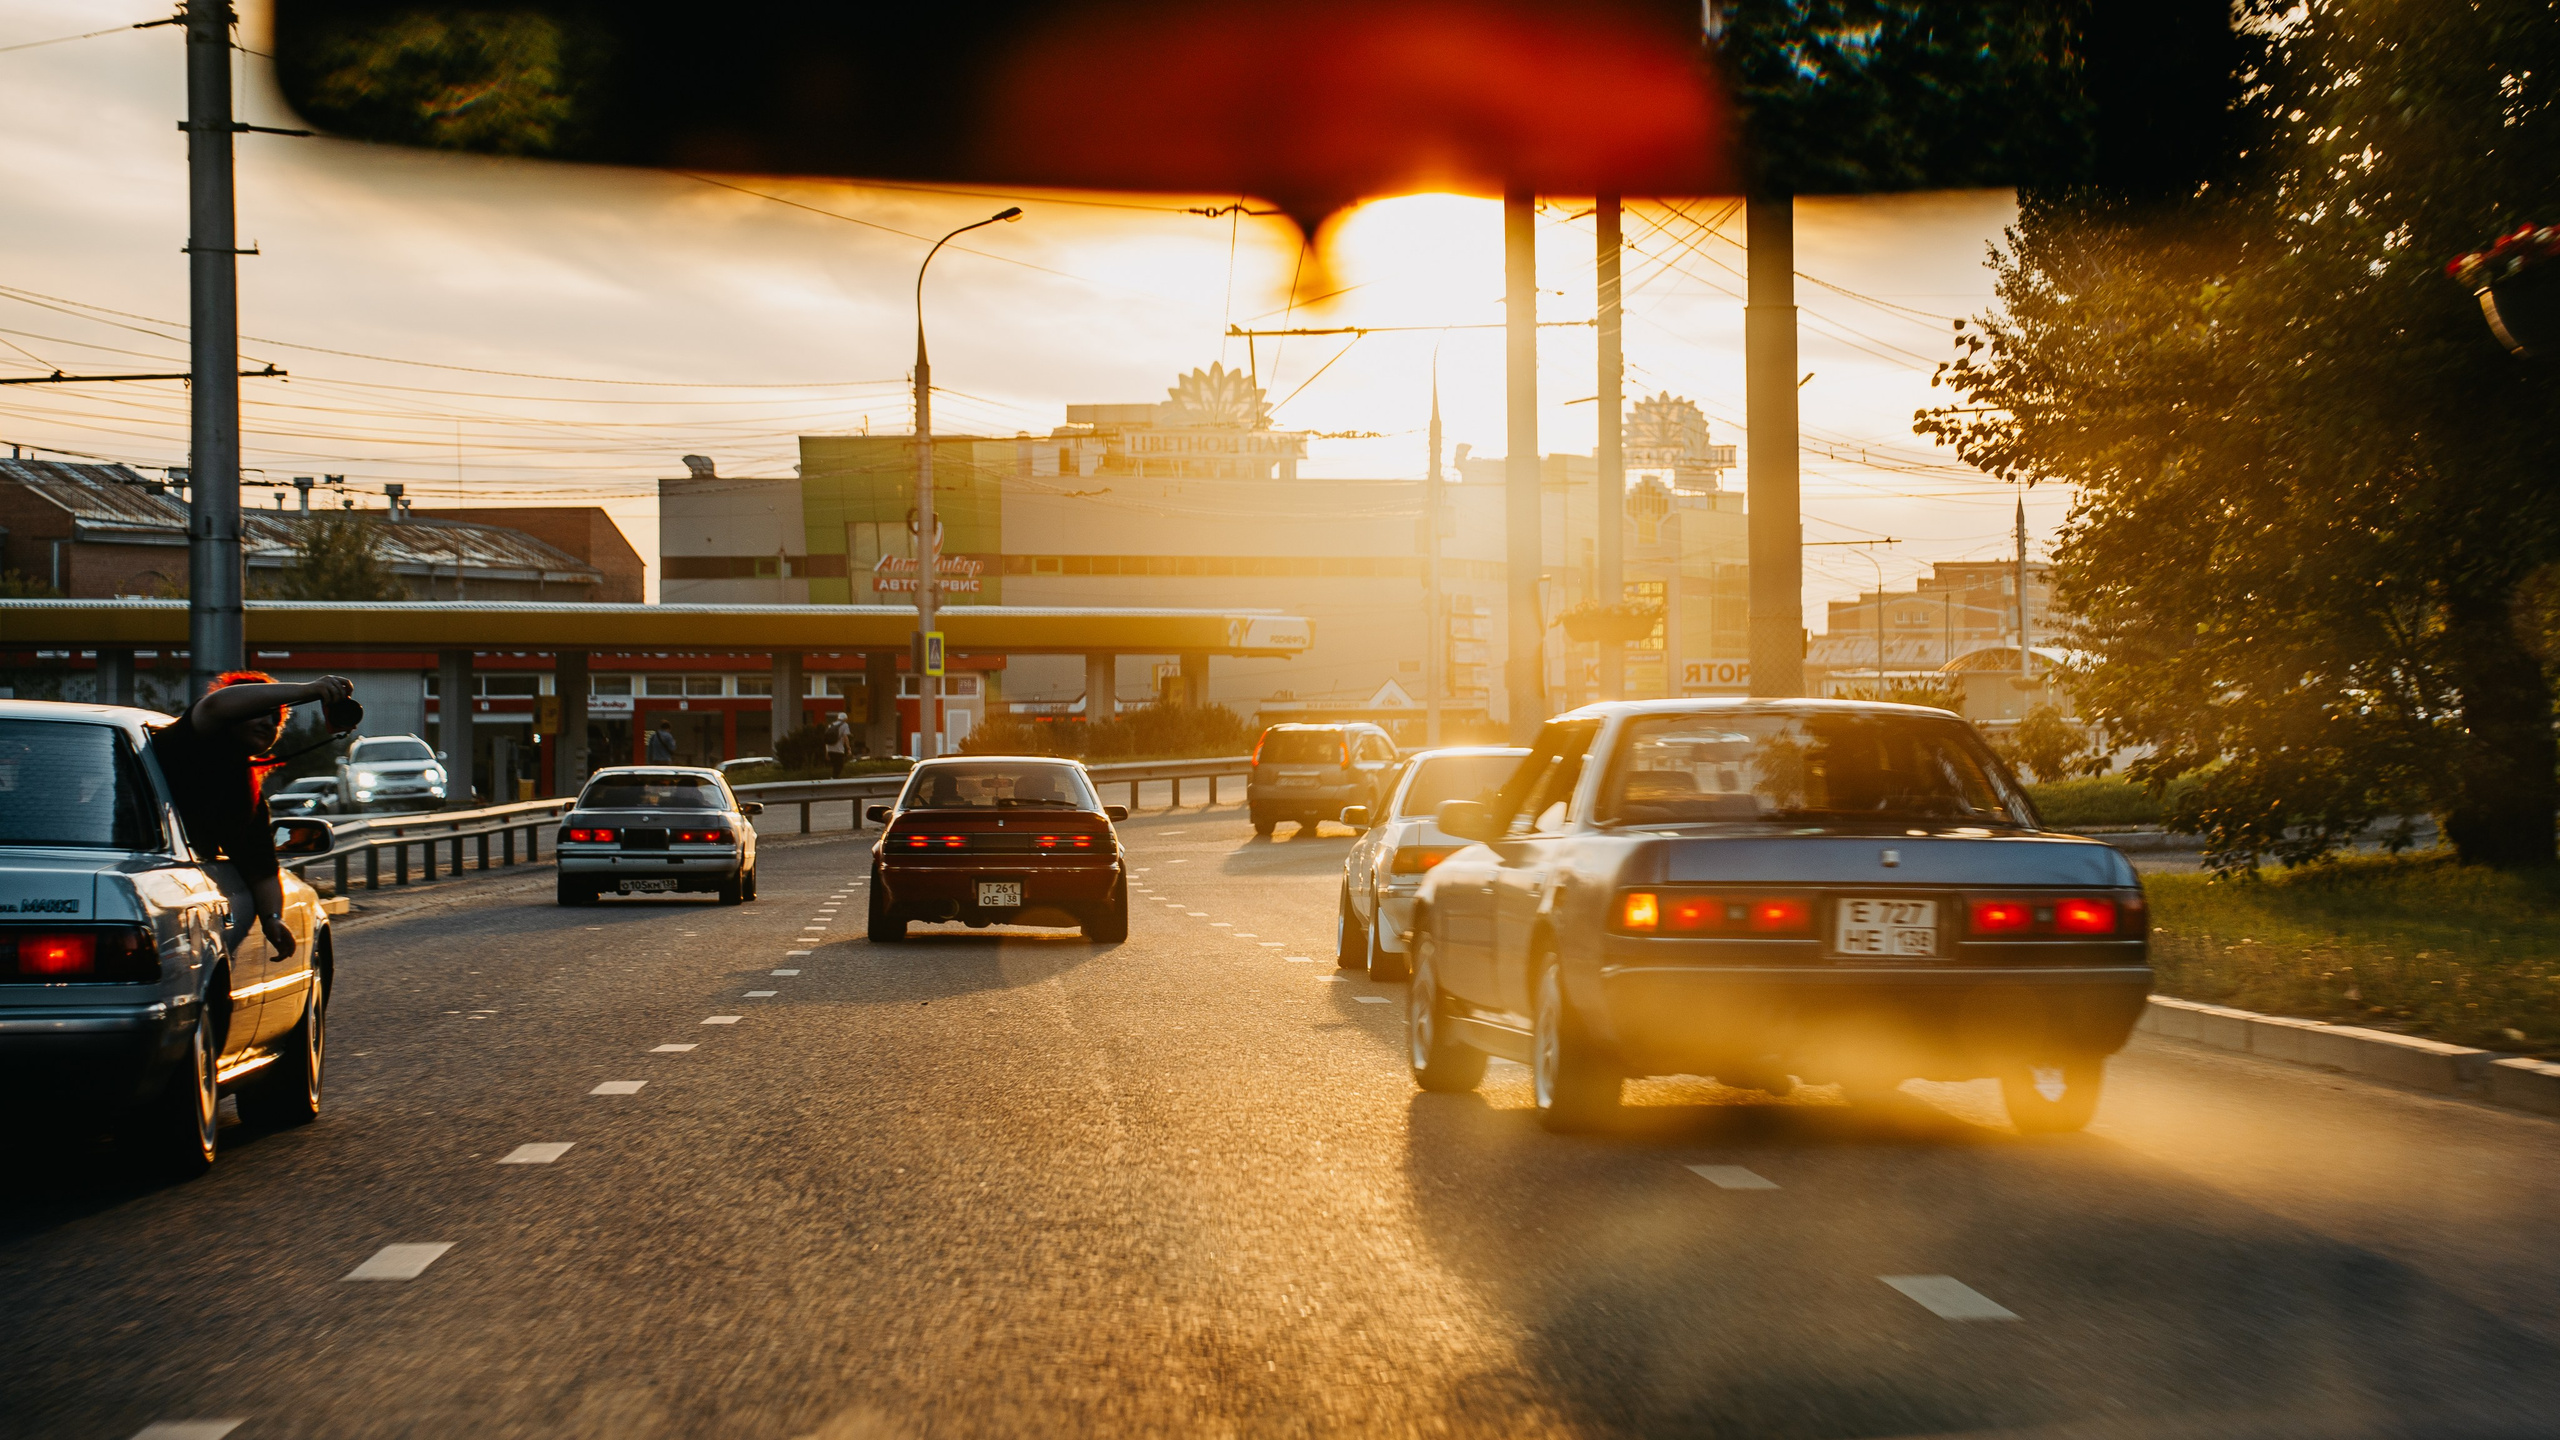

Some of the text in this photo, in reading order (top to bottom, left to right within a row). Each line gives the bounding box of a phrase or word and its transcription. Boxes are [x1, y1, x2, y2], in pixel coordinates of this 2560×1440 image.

[1247, 435, 1303, 455] ПАРК
[995, 884, 1015, 893] 261
[983, 895, 1017, 905] ОЕ 38
[1877, 901, 1925, 925] 727
[1844, 929, 1882, 952] НЕ
